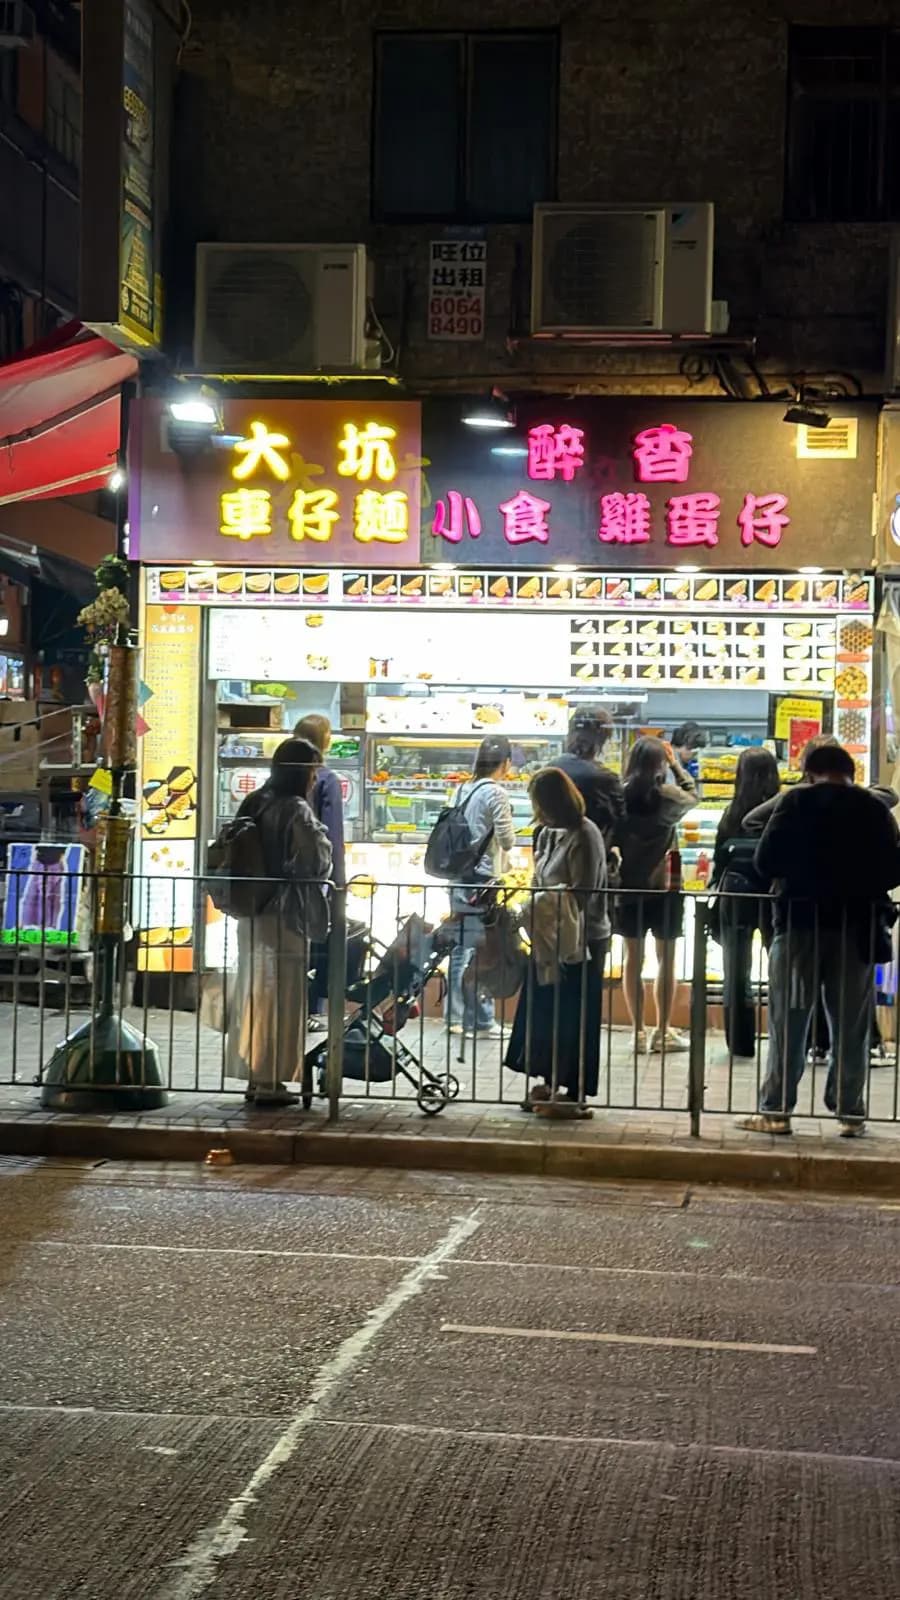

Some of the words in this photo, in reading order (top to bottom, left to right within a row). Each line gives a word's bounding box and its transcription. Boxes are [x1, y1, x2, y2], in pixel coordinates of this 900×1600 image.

[432, 242, 485, 262] 旺位
[432, 267, 483, 287] 出租
[430, 297, 481, 315] 6064
[430, 317, 482, 335] 8490
[231, 420, 397, 481] 大坑
[527, 424, 694, 483] 醉香
[219, 487, 409, 544] 車仔麵
[432, 490, 551, 545] 小食
[598, 491, 791, 547] 雞蛋仔
